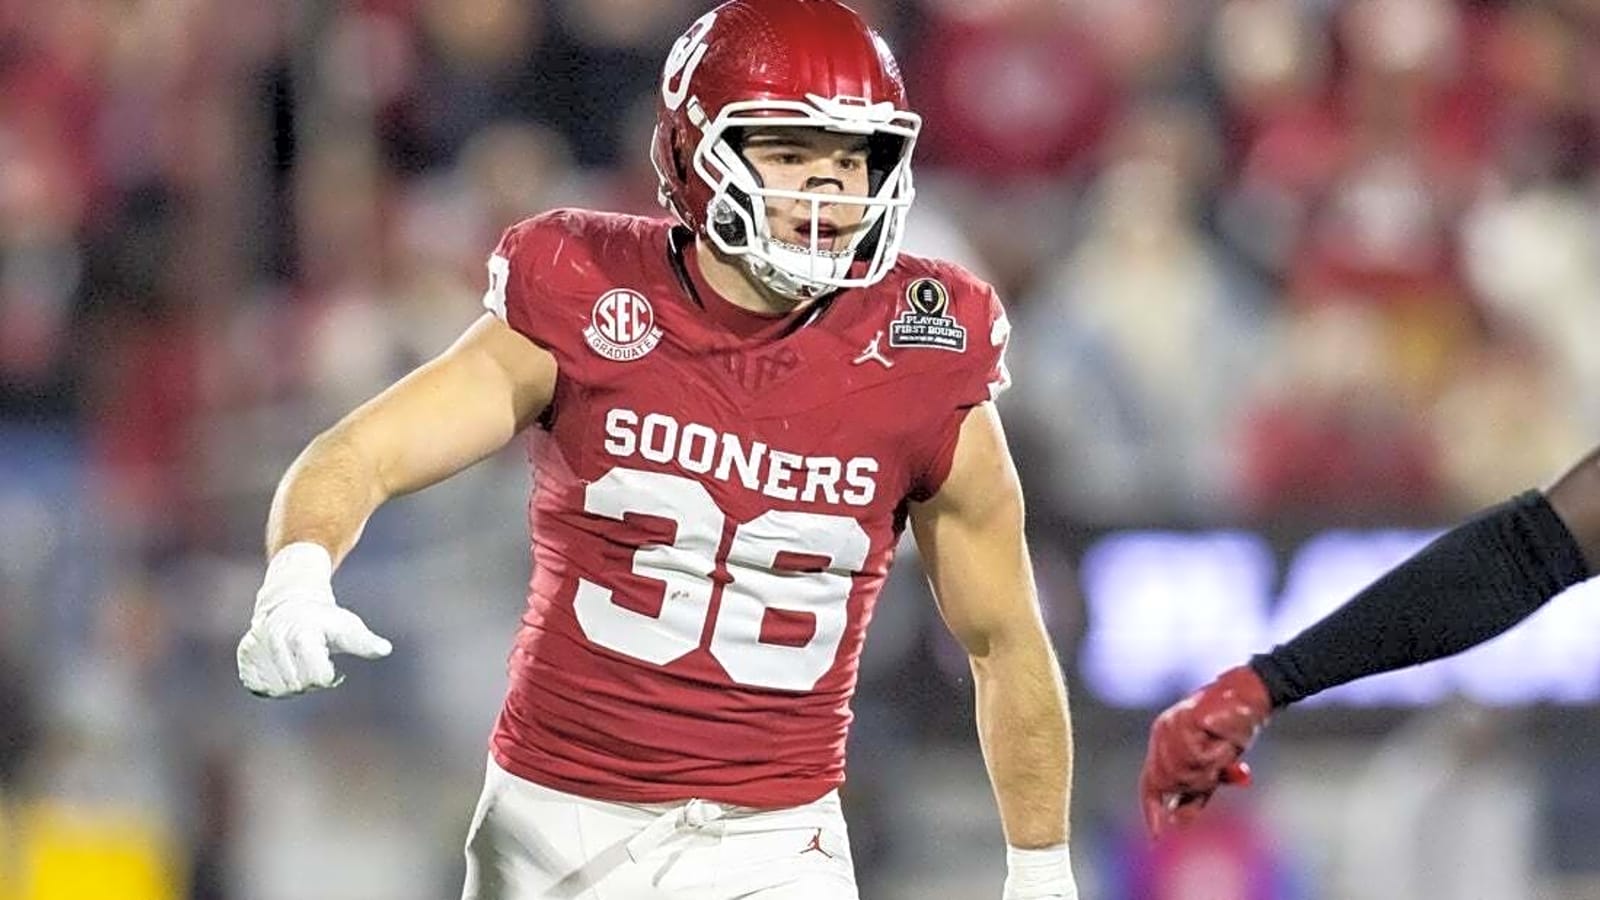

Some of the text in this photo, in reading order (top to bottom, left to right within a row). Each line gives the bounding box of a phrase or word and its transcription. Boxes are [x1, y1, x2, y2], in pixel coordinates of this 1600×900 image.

[598, 292, 648, 342] SEC
[894, 325, 963, 339] FIRST ROUND
[906, 315, 953, 327] PLAYOFF
[592, 337, 654, 359] GRADUATE
[604, 408, 879, 506] SOONERS
[572, 466, 871, 692] 38
